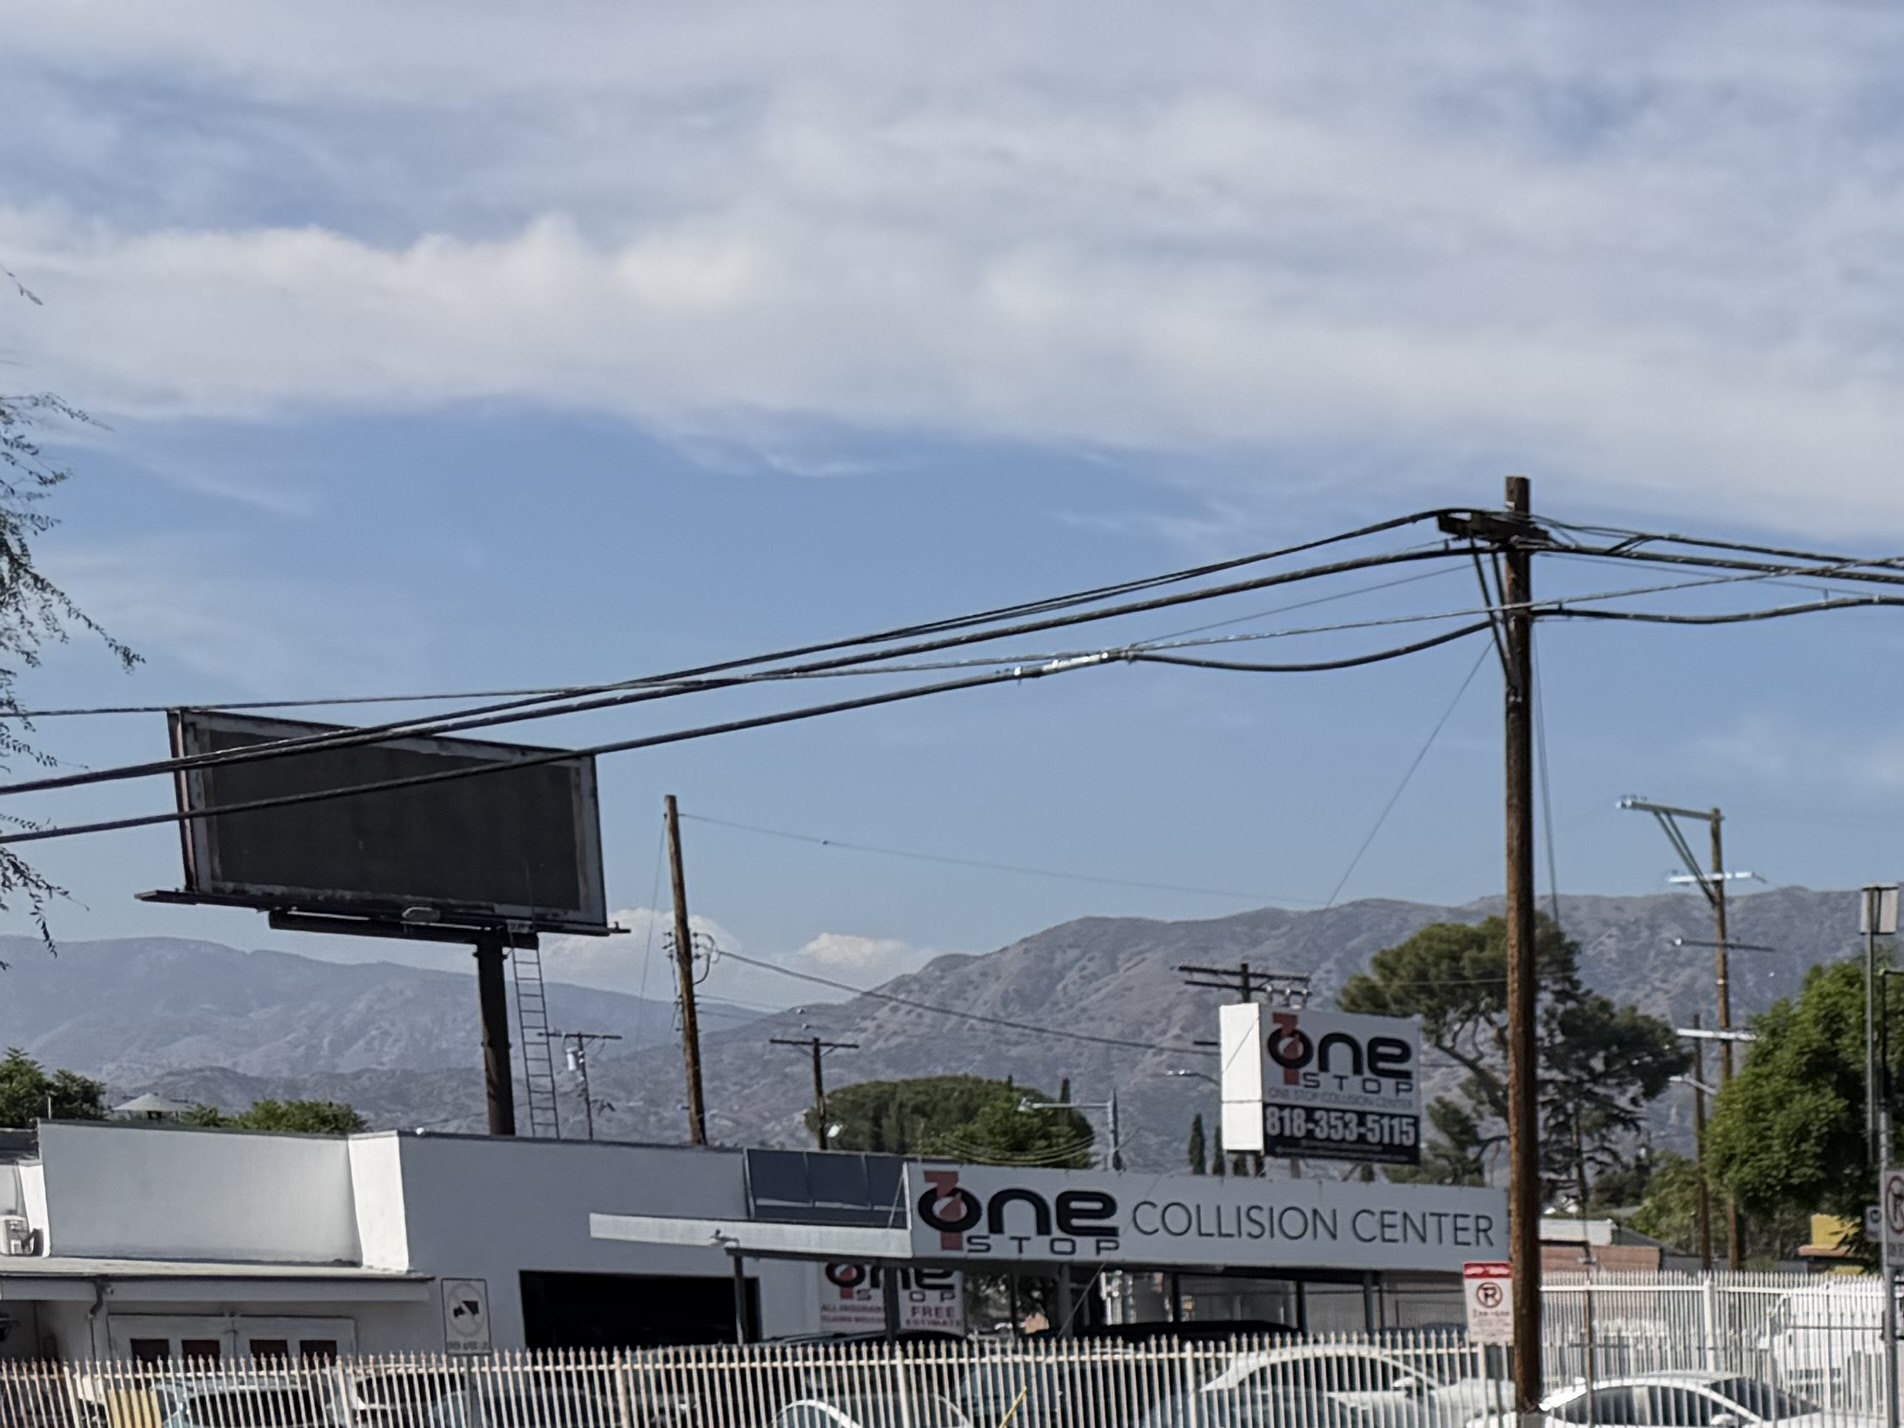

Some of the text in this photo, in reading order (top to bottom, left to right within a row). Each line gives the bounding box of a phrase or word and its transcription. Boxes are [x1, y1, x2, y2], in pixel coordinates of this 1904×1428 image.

[1303, 1072, 1413, 1096] STOP
[1266, 1106, 1416, 1147] 818-353-5115
[1132, 1200, 1494, 1248] COLLISION CENTER
[966, 1235, 1120, 1256] STOP
[911, 1306, 956, 1319] FREE
